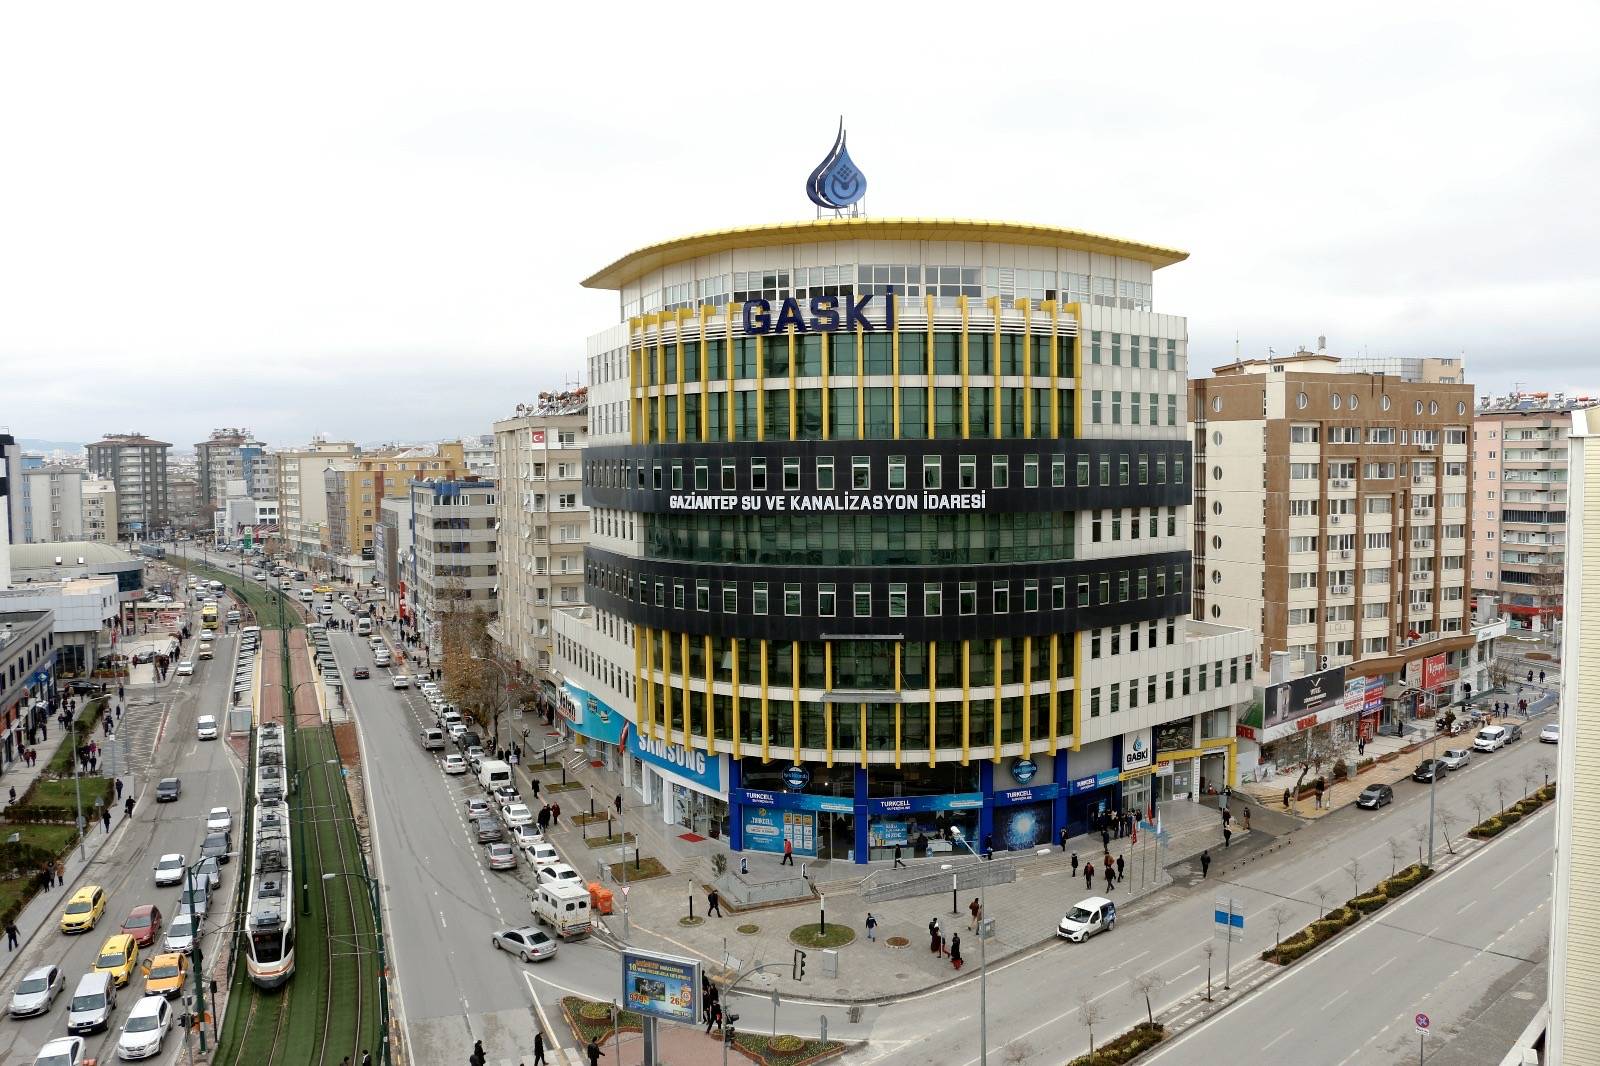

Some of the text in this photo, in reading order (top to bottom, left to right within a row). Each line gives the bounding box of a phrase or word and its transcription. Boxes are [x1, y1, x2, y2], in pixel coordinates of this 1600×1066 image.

[743, 285, 894, 335] GASKİ
[669, 490, 986, 511] GAZİANTEP SU VE KANALİZASYON İDARESİ
[638, 734, 706, 775] SAMSUNG
[1126, 748, 1148, 763] GASKİ
[746, 792, 774, 801] TURKCELL
[1006, 789, 1033, 799] TURKCELL
[880, 800, 911, 808] TURKCELL
